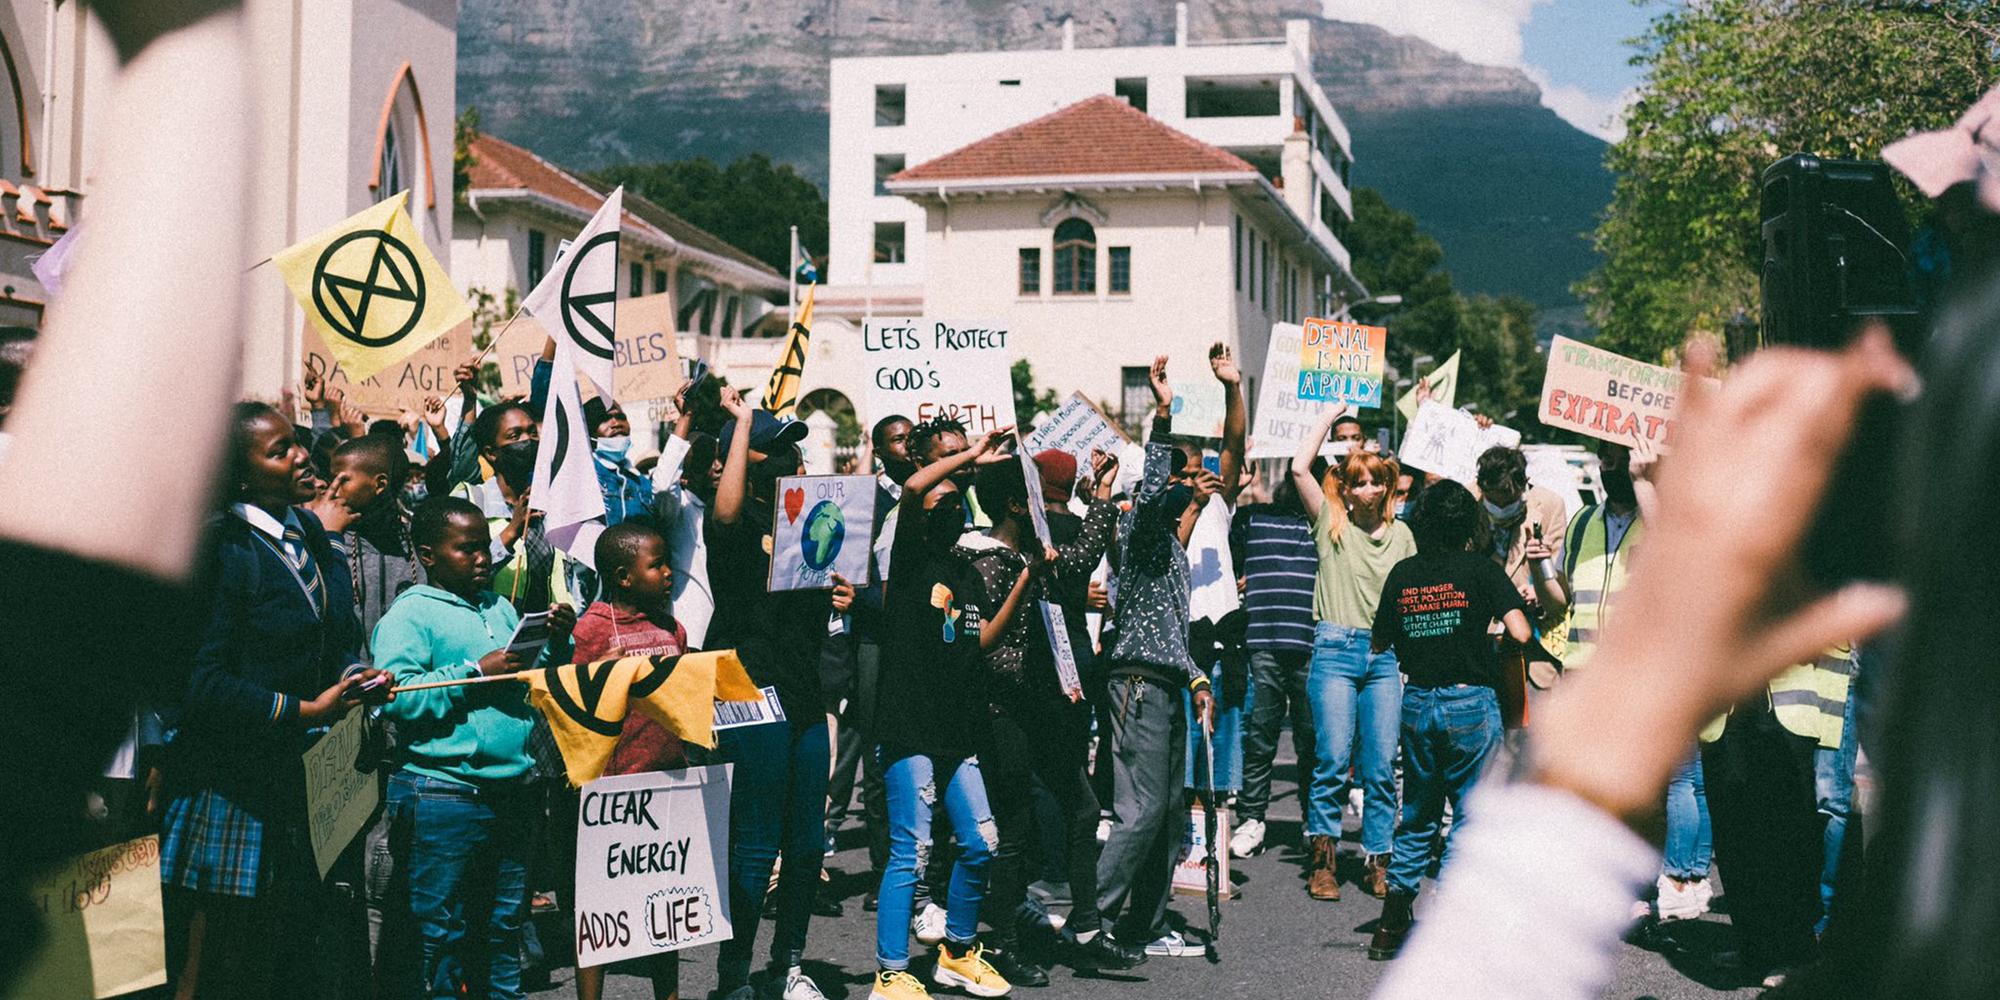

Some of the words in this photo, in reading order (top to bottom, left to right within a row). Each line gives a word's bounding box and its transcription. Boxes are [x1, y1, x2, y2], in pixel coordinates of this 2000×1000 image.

[864, 319, 920, 351] LET'S
[935, 322, 1008, 351] PROTECT
[1307, 323, 1375, 352] DENIAL
[875, 360, 941, 391] GOD'S
[1317, 350, 1333, 370] IS
[1339, 353, 1372, 373] NOT
[397, 362, 448, 392] AGE
[1301, 372, 1316, 395] A
[1320, 373, 1380, 402] POLICY
[1607, 380, 1675, 409] BEFORE
[1268, 419, 1295, 440] USE
[816, 481, 845, 499] OUR
[1402, 588, 1418, 596] END
[1420, 584, 1453, 594] HUNGER
[582, 788, 660, 831] CLEAR
[606, 836, 691, 879] ENERGY
[578, 910, 631, 956] ADDS
[650, 896, 700, 942] LIFE
